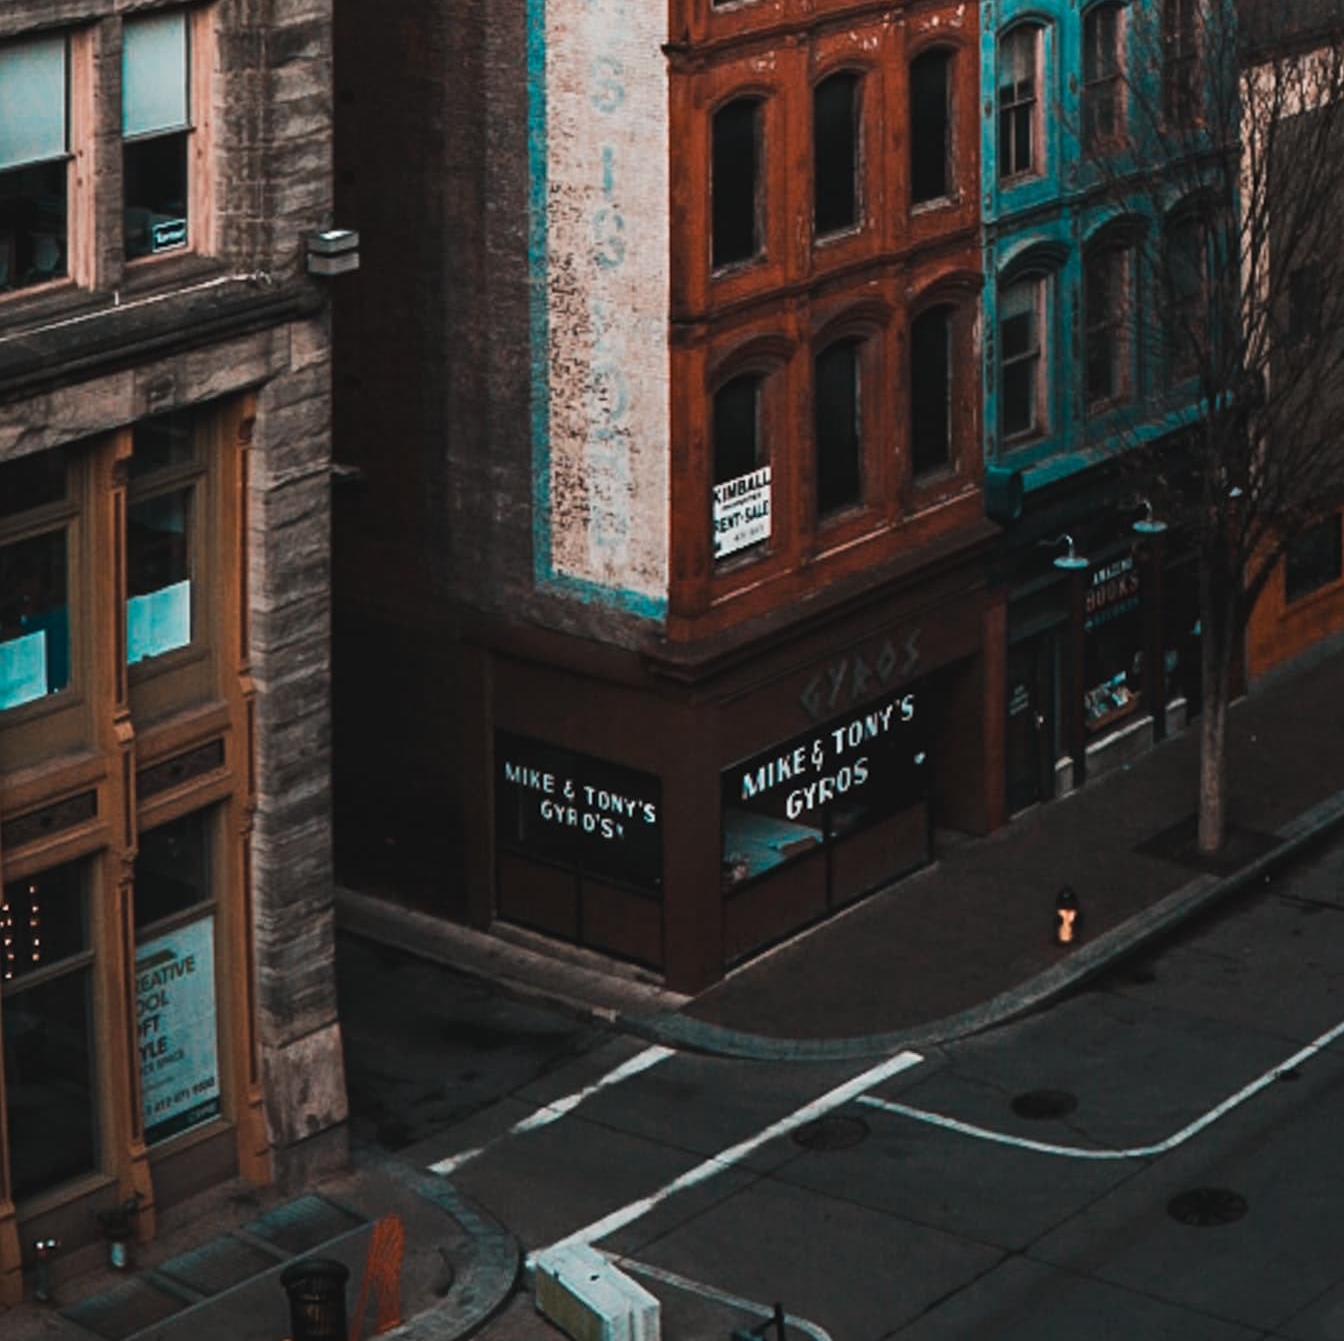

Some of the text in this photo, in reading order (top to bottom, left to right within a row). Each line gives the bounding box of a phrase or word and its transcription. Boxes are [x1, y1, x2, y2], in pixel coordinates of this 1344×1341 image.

[801, 628, 920, 720] GYROS
[741, 693, 915, 801] MIKE & TONY'S
[505, 761, 656, 824] MIKE & TONY'S
[785, 756, 868, 819] GYROS
